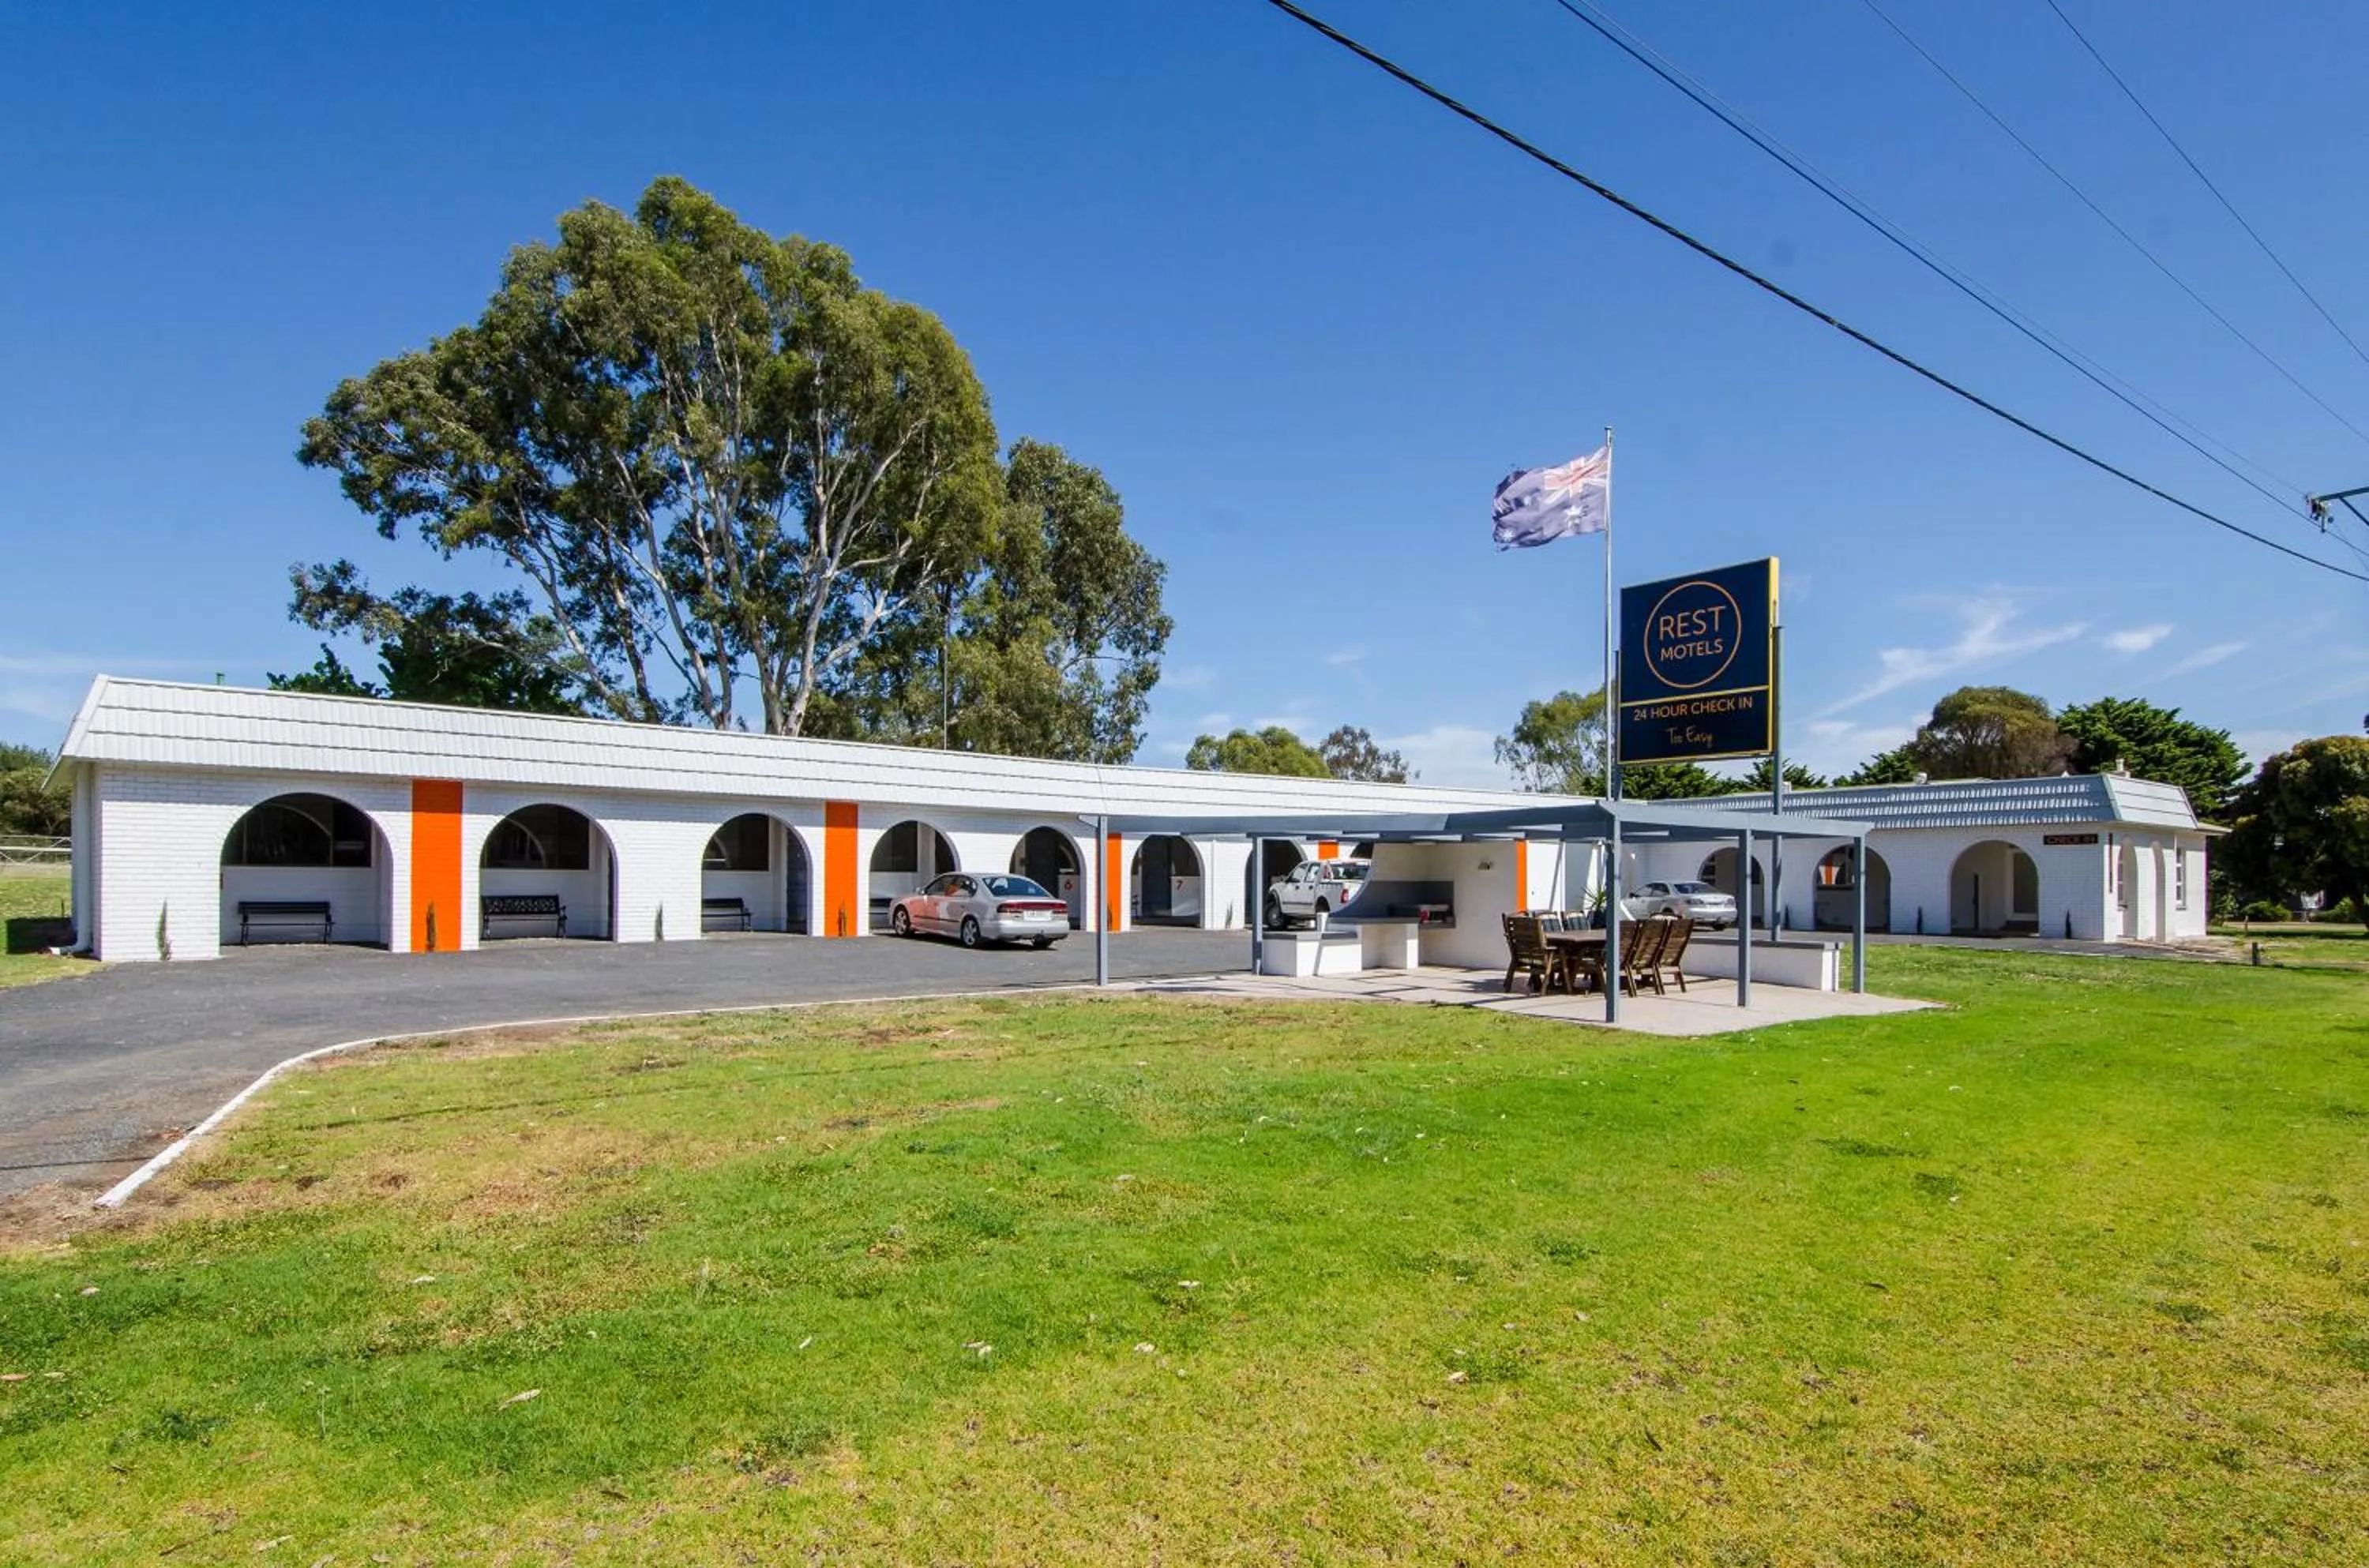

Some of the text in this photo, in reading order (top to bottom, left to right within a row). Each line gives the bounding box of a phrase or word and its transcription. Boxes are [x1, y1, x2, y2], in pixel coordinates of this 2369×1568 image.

[1659, 606, 1726, 641] REST
[1661, 638, 1723, 661] MOTELS
[1633, 696, 1752, 721] 24 HOUR CHECK IN
[1175, 880, 1184, 891] 7
